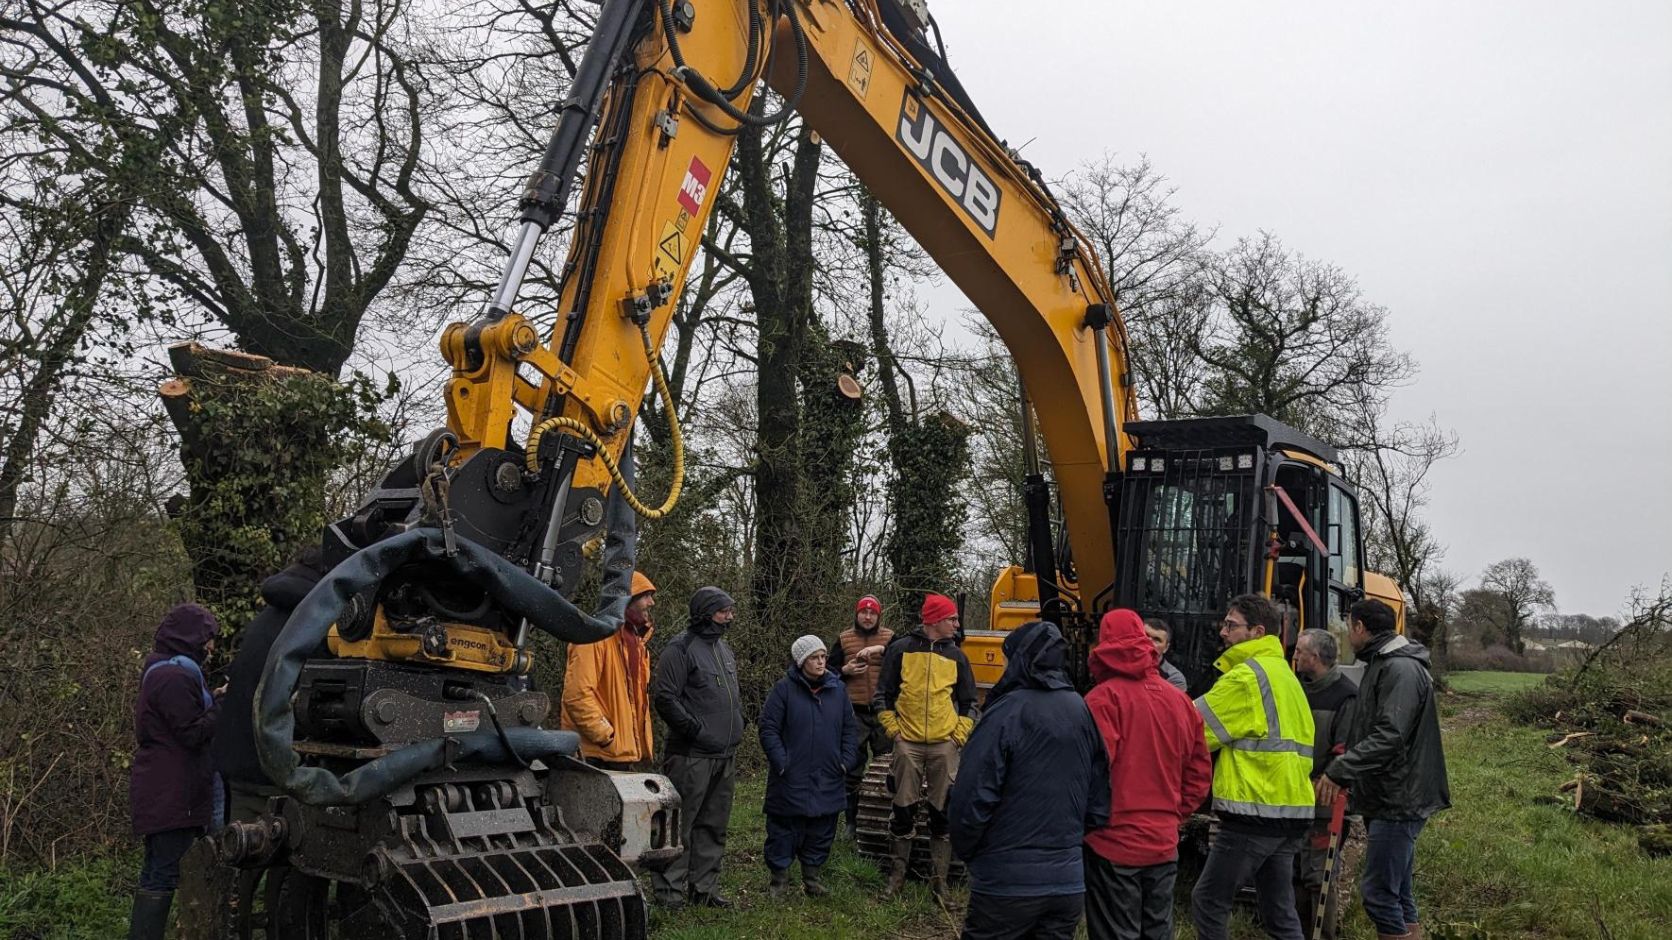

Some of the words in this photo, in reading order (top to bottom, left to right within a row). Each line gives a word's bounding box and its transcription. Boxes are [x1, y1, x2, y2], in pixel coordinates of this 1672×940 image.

[681, 171, 706, 205] M3
[901, 112, 998, 231] JCB
[450, 638, 487, 651] engcon
